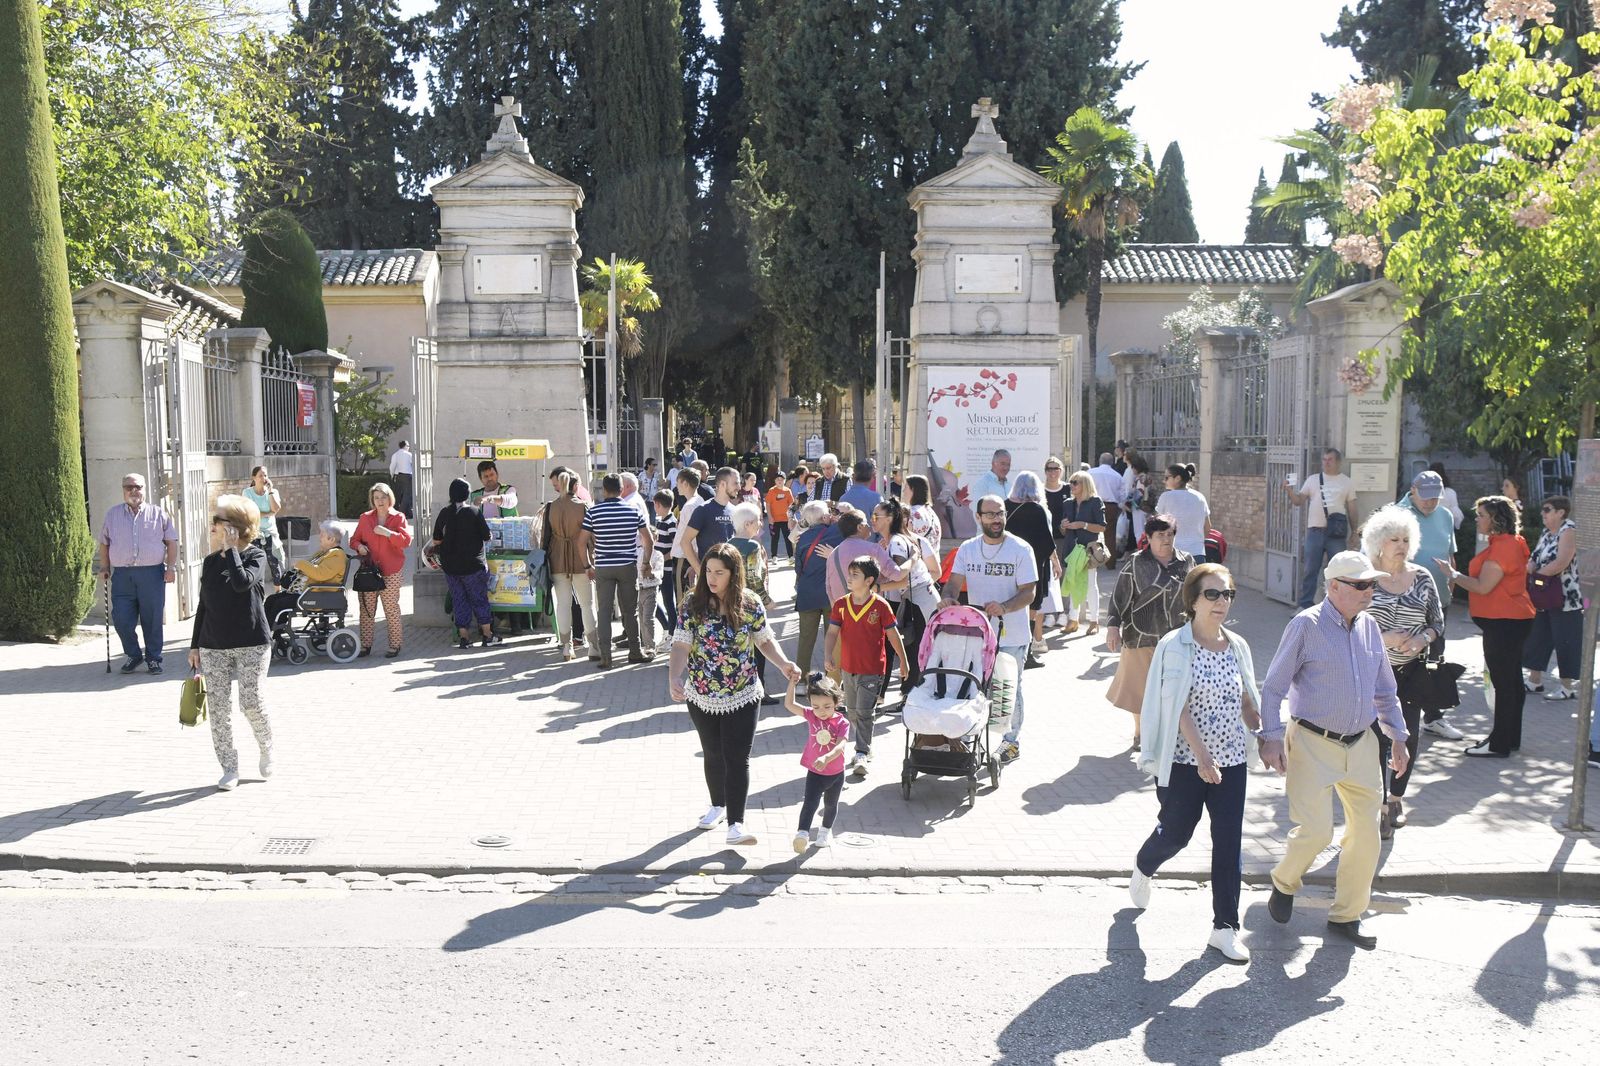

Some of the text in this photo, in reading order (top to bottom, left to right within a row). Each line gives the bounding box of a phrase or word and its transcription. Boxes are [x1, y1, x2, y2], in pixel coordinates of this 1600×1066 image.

[1005, 414, 1026, 425] para
[1028, 412, 1039, 423] el
[966, 427, 1040, 435] RECUERDO 2022
[496, 448, 525, 456] ONCE
[967, 563, 981, 572] SAN
